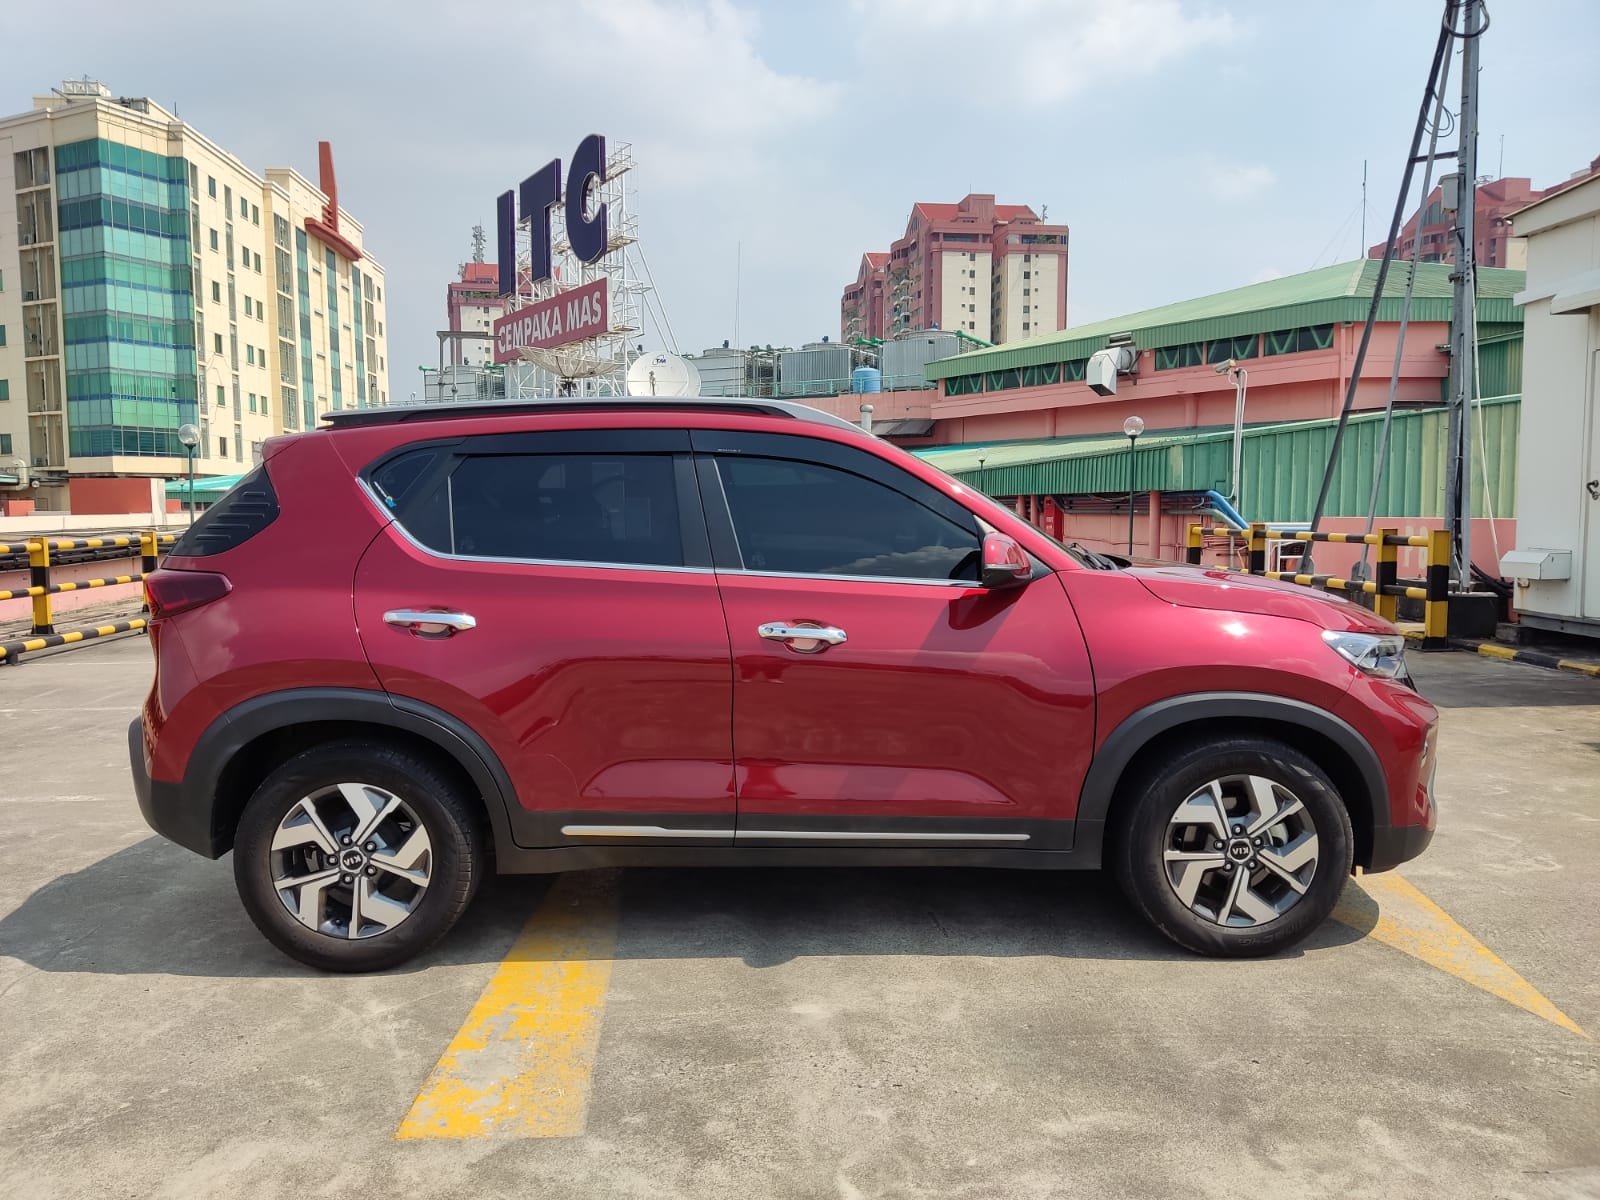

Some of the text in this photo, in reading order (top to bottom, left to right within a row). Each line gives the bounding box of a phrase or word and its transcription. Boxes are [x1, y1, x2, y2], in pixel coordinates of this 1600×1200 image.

[497, 134, 607, 299] ITC
[498, 291, 602, 354] CEMPAKA MAS
